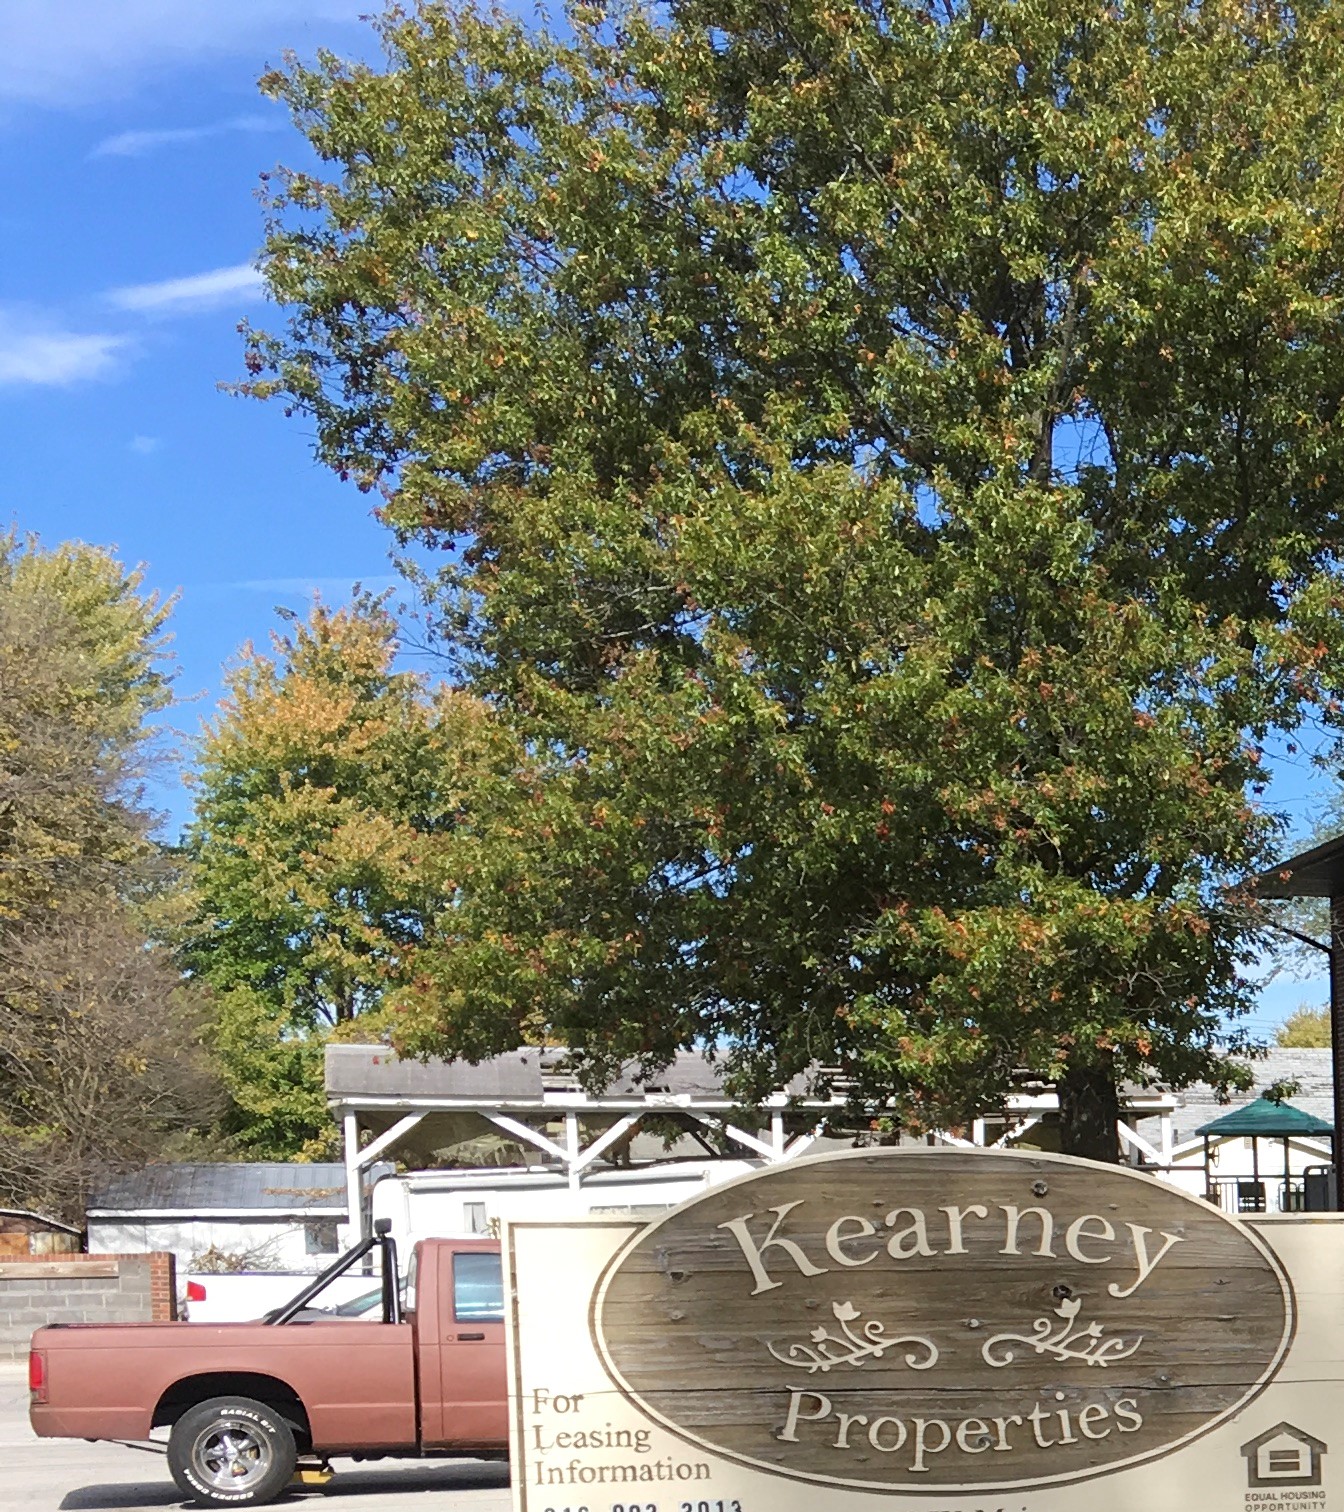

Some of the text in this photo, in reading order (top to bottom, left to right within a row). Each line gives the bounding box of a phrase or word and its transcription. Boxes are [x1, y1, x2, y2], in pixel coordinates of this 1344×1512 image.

[717, 1199, 1185, 1298] Kearney
[532, 1388, 584, 1414] For
[532, 1422, 652, 1454] Leasing
[776, 1385, 1143, 1472] Properties
[534, 1456, 712, 1486] Information
[1245, 1490, 1327, 1502] EQUAL HOUSING
[1245, 1501, 1327, 1512] OPPORTUNITY
